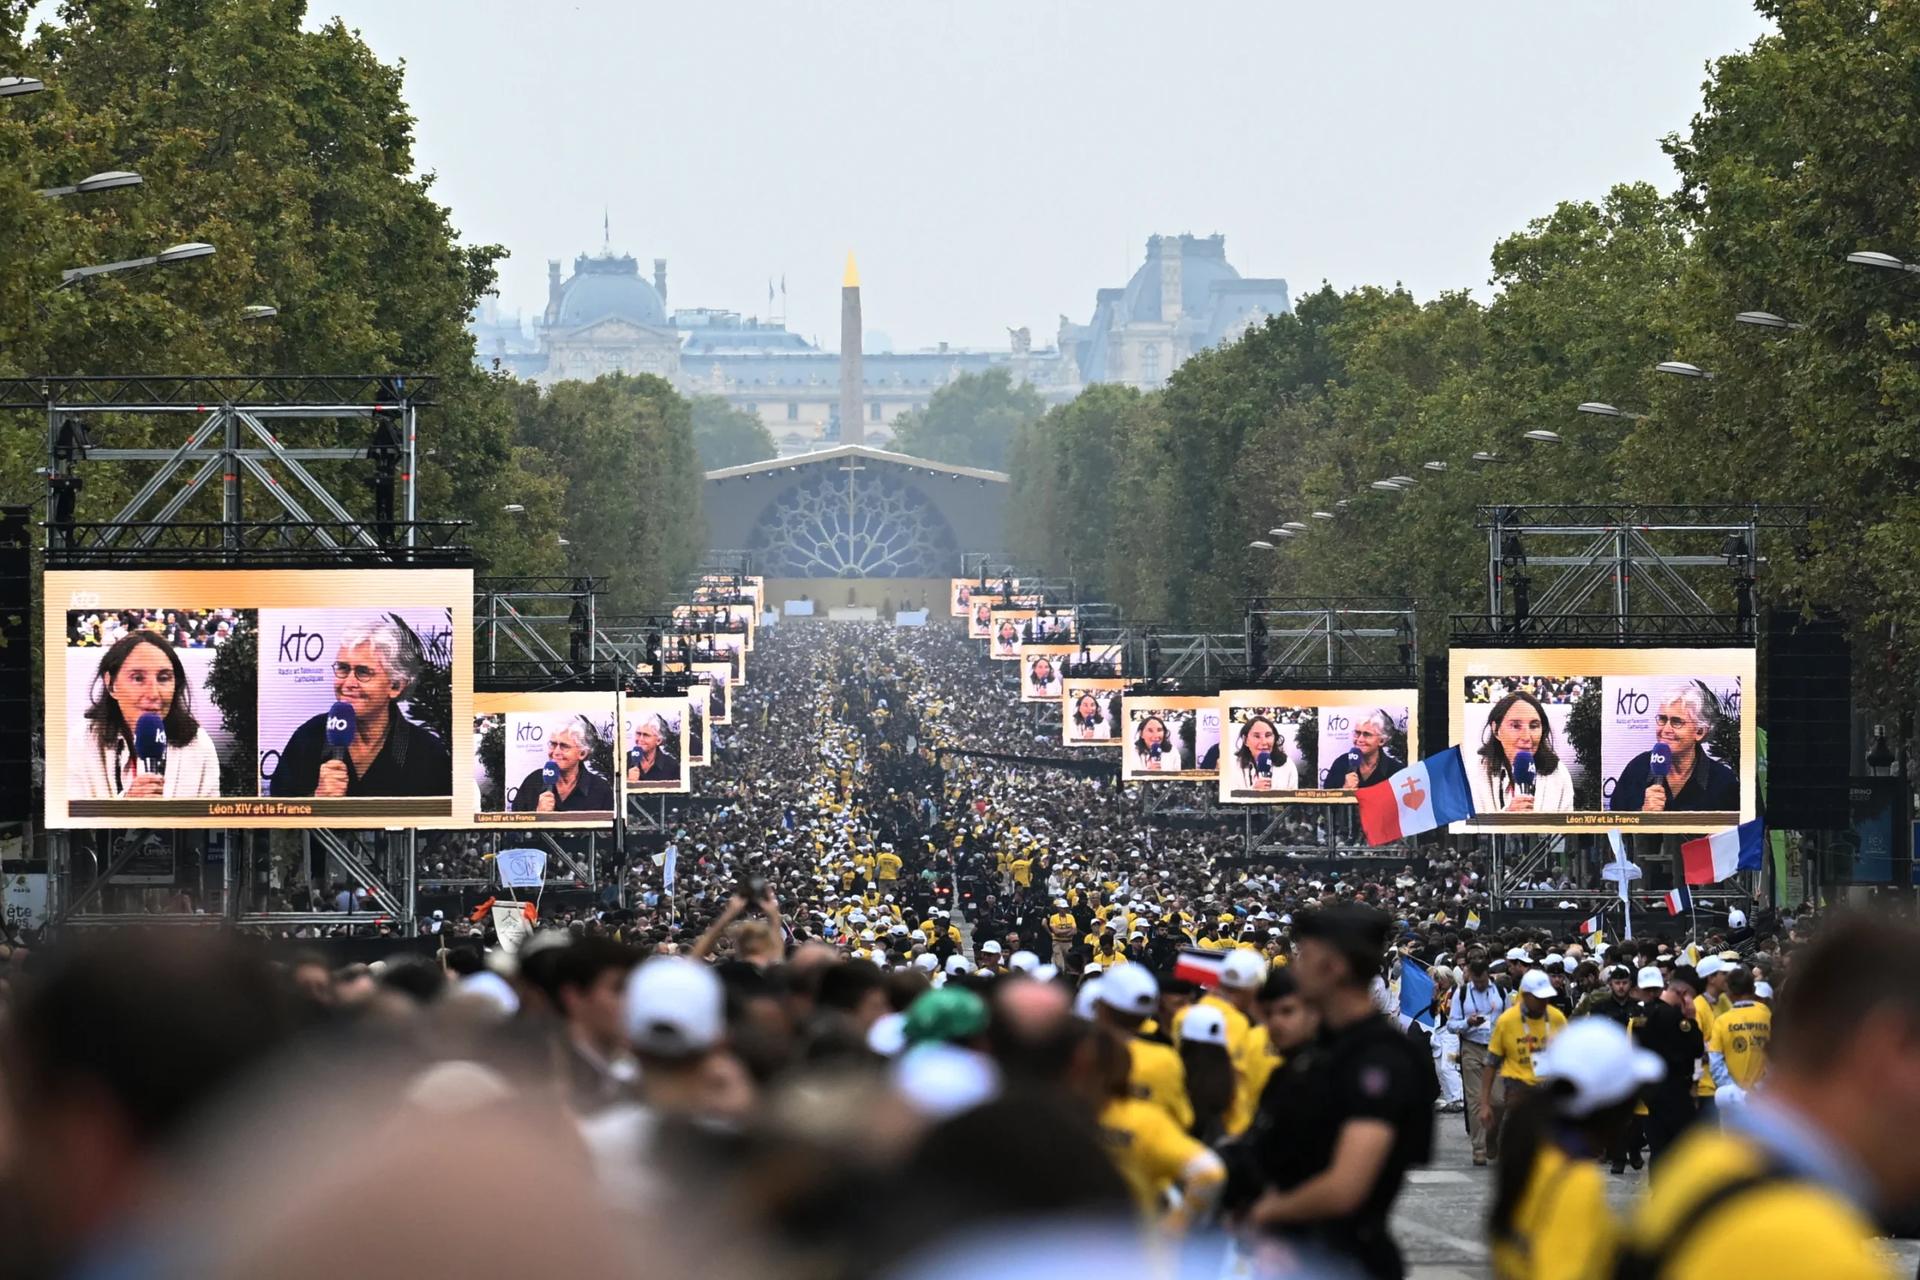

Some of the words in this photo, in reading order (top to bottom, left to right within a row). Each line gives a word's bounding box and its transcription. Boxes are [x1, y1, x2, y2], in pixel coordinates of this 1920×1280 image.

[278, 625, 324, 662] kto
[429, 625, 452, 662] kt
[1616, 688, 1649, 715] kto
[327, 716, 347, 731] kto
[1327, 714, 1349, 730] kto
[516, 721, 543, 741] kto
[1650, 753, 1665, 763] kto
[209, 803, 233, 814] Léon
[235, 804, 251, 814] XIV
[253, 804, 265, 814] et
[266, 804, 275, 814] la
[277, 804, 312, 814] France
[1566, 815, 1583, 824] Léon
[1584, 816, 1597, 824] XIV
[1597, 816, 1606, 824] et
[1607, 816, 1613, 824] la
[1615, 816, 1640, 824] France
